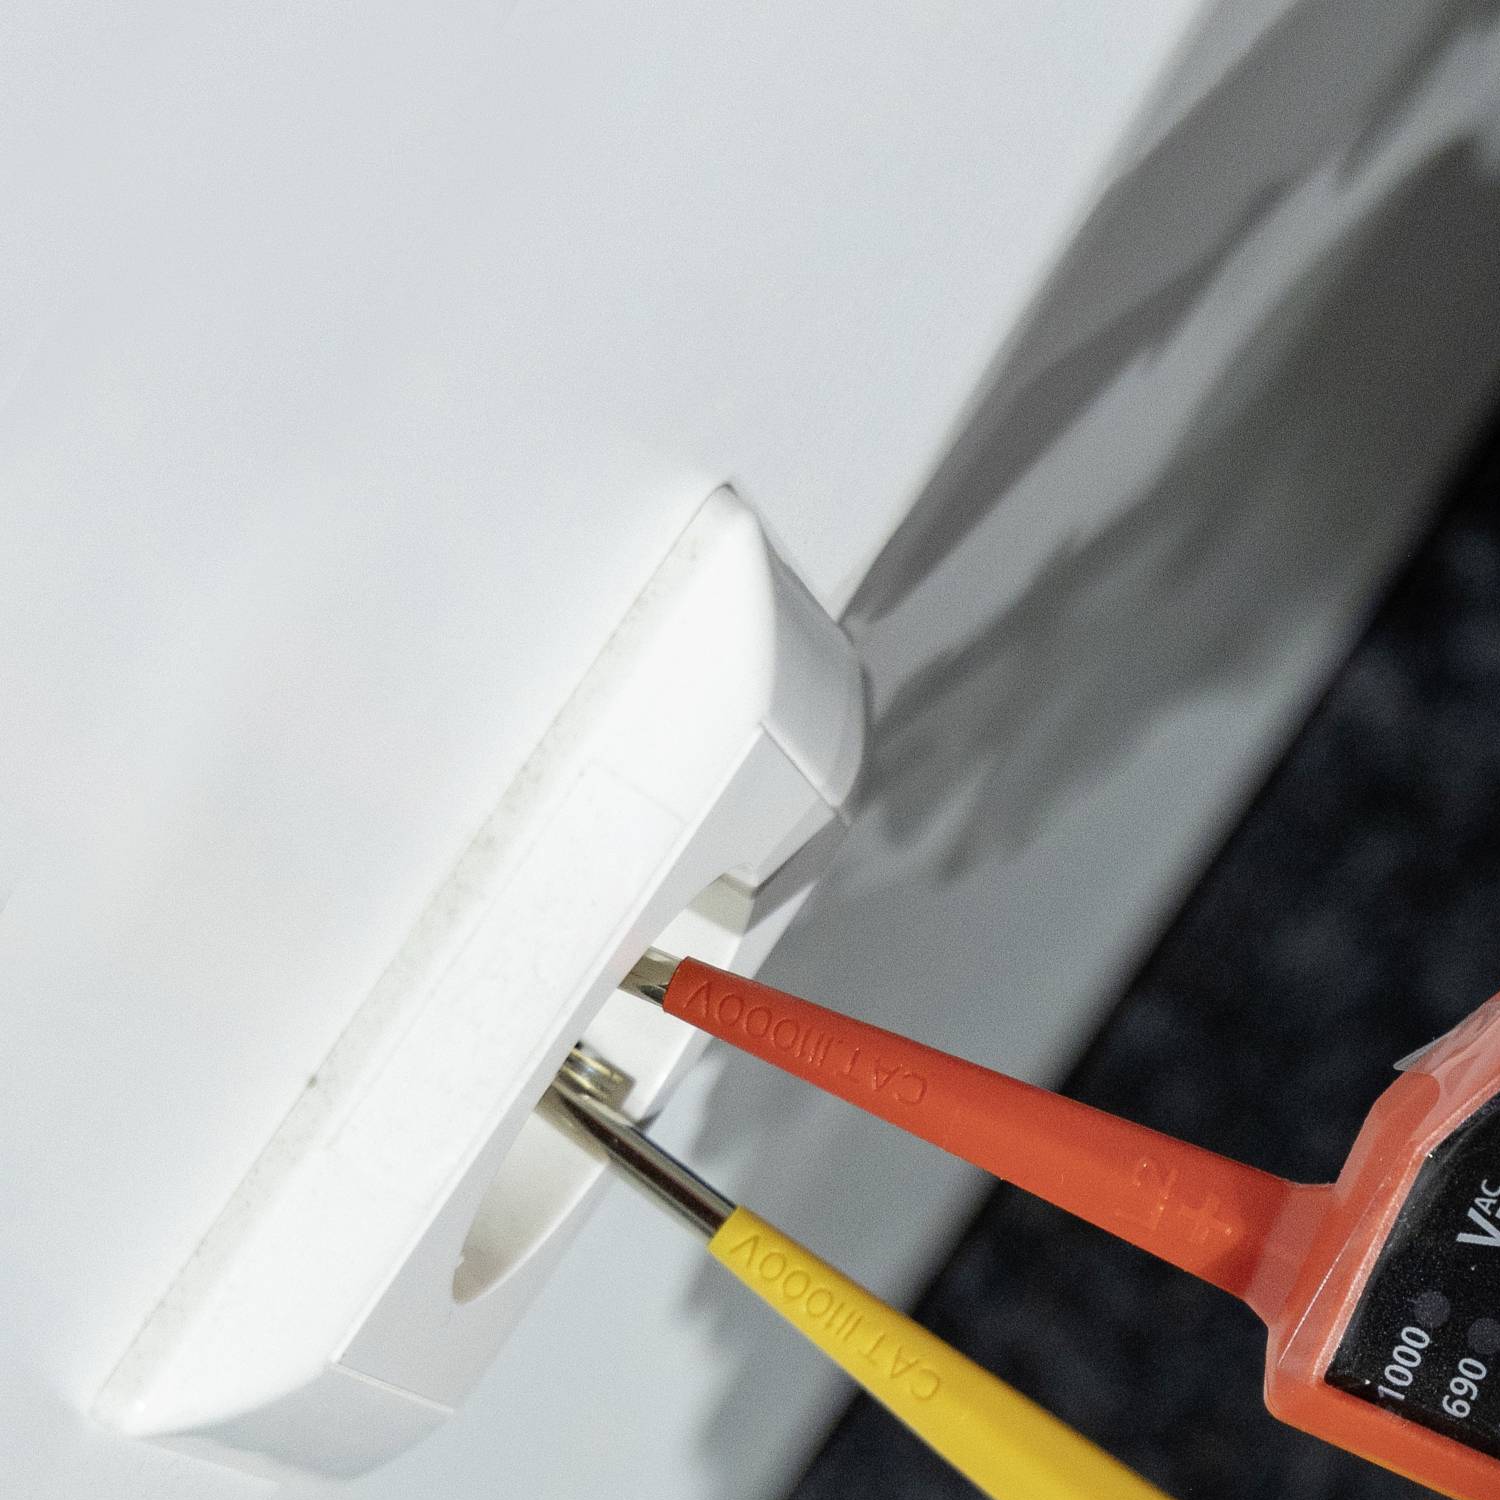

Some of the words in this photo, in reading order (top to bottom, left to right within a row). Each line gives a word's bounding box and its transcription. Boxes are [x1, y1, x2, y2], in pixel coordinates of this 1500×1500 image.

[838, 1046, 928, 1105] CAT
[858, 1334, 941, 1400] CAT
[1377, 1326, 1431, 1401] 1000
[1442, 1357, 1487, 1418] 690
